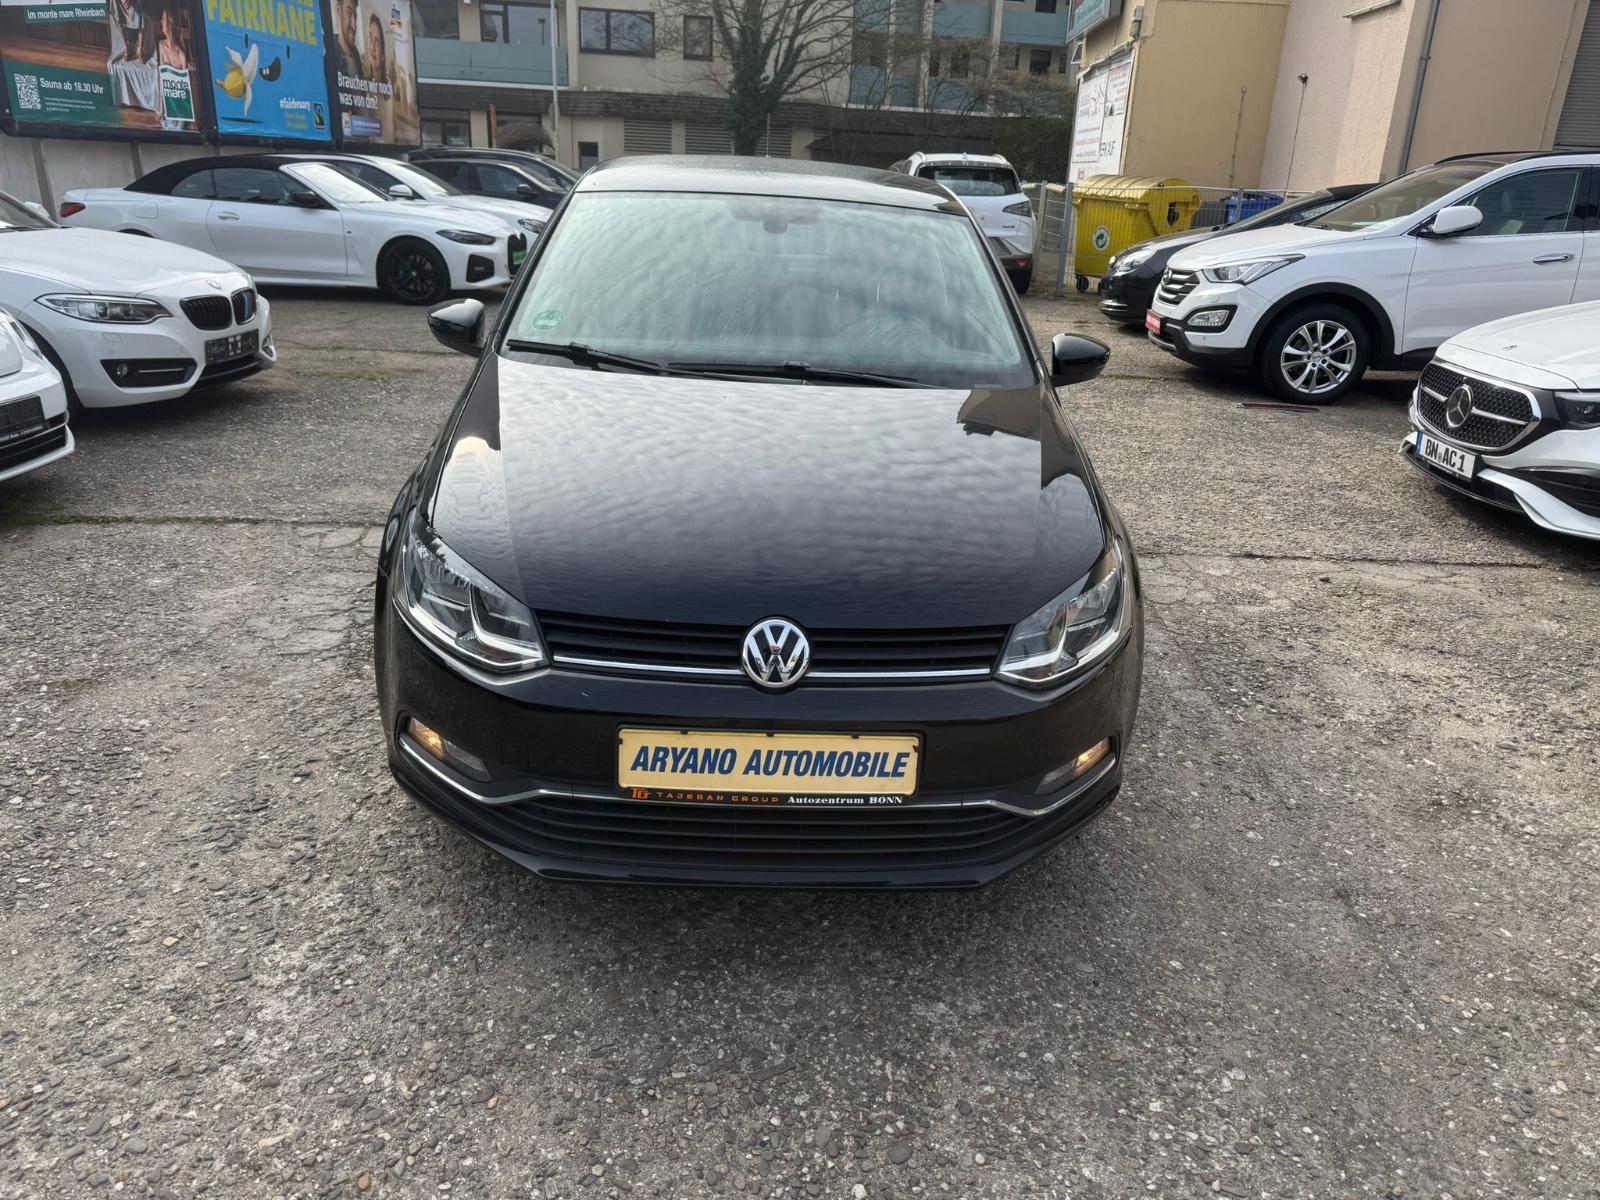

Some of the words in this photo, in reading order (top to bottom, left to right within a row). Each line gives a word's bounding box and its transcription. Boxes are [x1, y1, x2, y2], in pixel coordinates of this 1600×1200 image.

[38, 9, 58, 19] monte
[59, 9, 74, 18] mare
[75, 7, 106, 17] Rheinbach
[40, 77, 63, 90] Sauna
[64, 81, 73, 91] ab
[74, 82, 92, 93] 18.30
[92, 84, 104, 94] Uhr
[163, 79, 189, 91] monte
[337, 71, 369, 92] Brauchen
[368, 79, 378, 93] wir
[379, 80, 393, 96] noch
[164, 88, 187, 99] mare
[339, 92, 353, 106] was
[353, 95, 365, 108] von
[366, 94, 378, 110] dm?
[1425, 438, 1439, 460] BN
[1442, 447, 1457, 468] AC
[1457, 454, 1466, 473] 1
[743, 619, 809, 687] VW
[630, 745, 737, 775] ARYANO
[743, 749, 911, 777] AUTOMOBILE
[788, 796, 865, 804] Autozentrum
[869, 796, 903, 804] BONN
